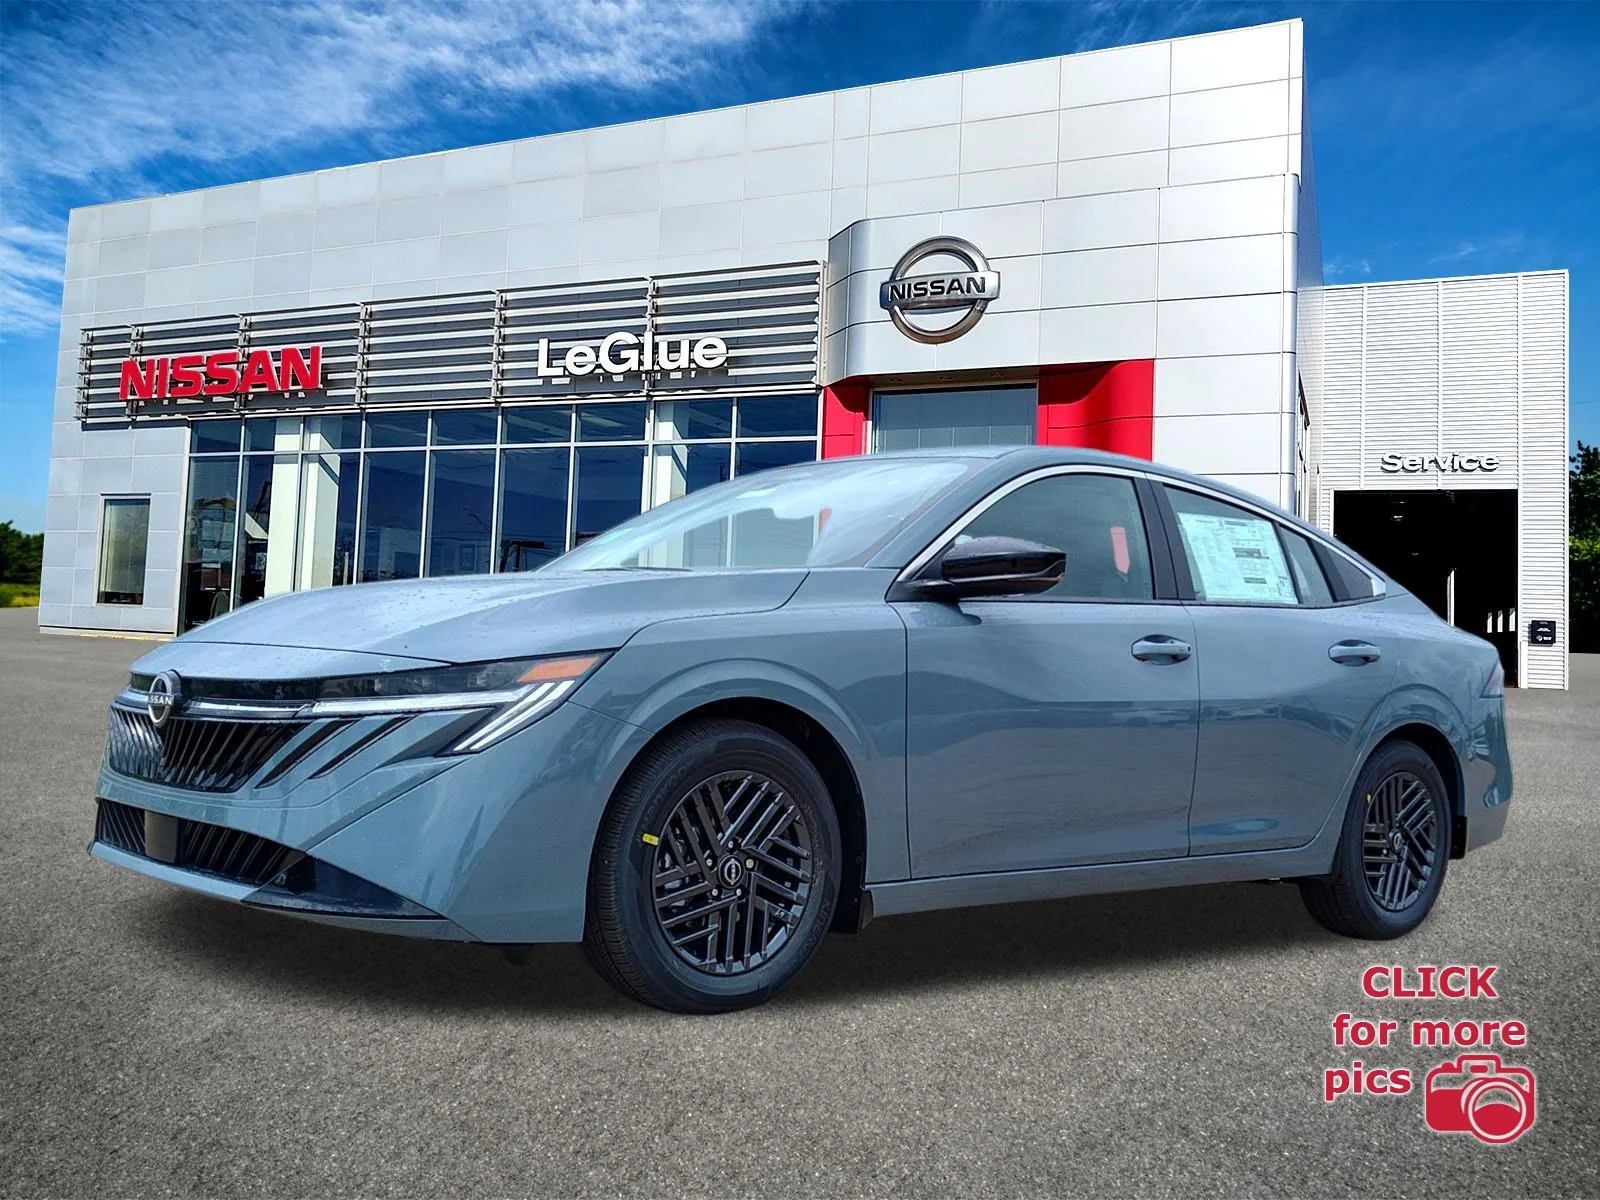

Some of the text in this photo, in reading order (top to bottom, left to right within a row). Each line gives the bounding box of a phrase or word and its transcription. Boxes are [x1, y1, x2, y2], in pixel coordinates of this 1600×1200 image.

[888, 277, 986, 301] NISSAN
[537, 331, 728, 377] LeGlue
[119, 345, 323, 400] NISSAN
[1381, 451, 1499, 473] Service
